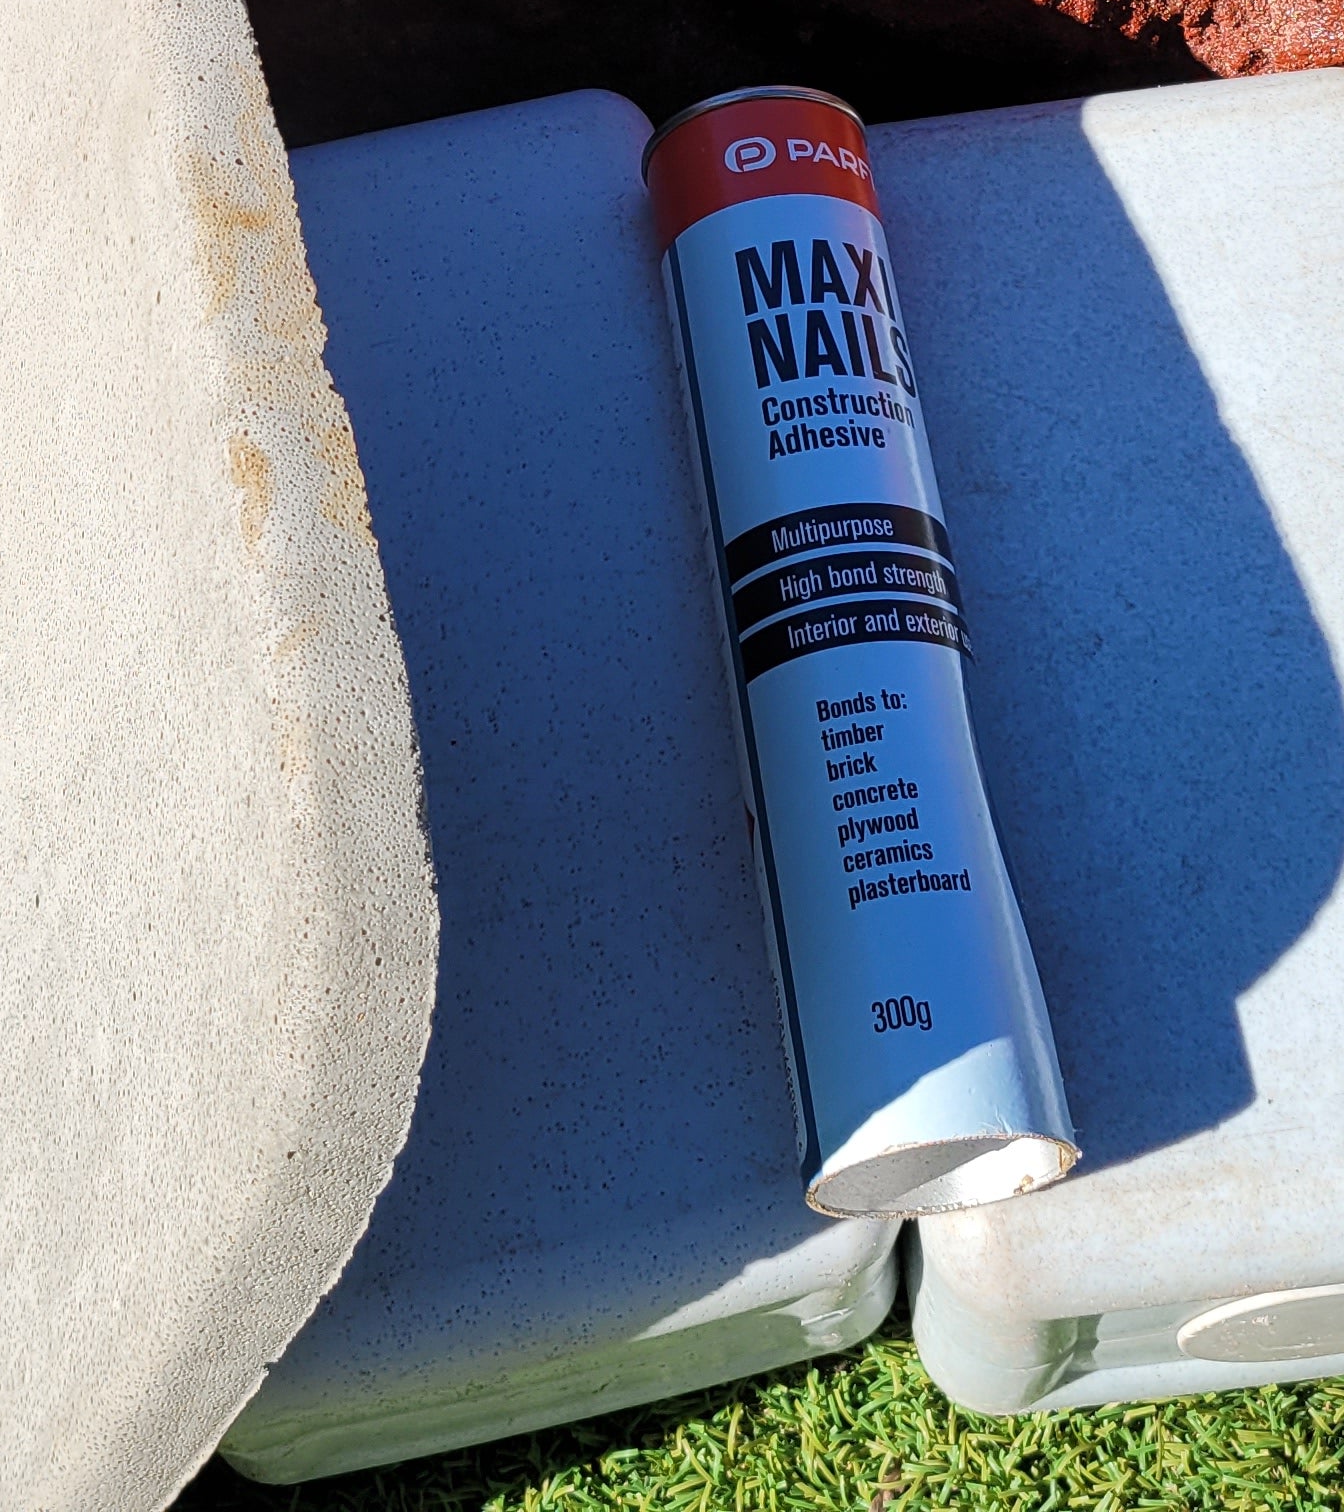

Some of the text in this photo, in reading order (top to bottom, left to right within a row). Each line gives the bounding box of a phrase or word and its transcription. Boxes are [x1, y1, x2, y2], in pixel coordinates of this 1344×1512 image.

[734, 238, 897, 323] MAXI
[746, 309, 917, 399] NAILS
[761, 387, 915, 429] Construction
[768, 418, 886, 461] Adhesive
[771, 518, 895, 553] Multipurpose
[779, 561, 947, 601] High bond strength
[787, 614, 858, 649] Interior
[864, 607, 900, 633] and
[905, 612, 959, 643] exterior
[815, 688, 908, 722] Bonds to:
[820, 722, 885, 752] timber
[825, 751, 879, 782] brick
[832, 777, 919, 812] concrete
[836, 807, 920, 848] plywood
[842, 838, 934, 874] ceramics
[847, 868, 972, 910] plasterboard
[870, 994, 934, 1033] 300g
